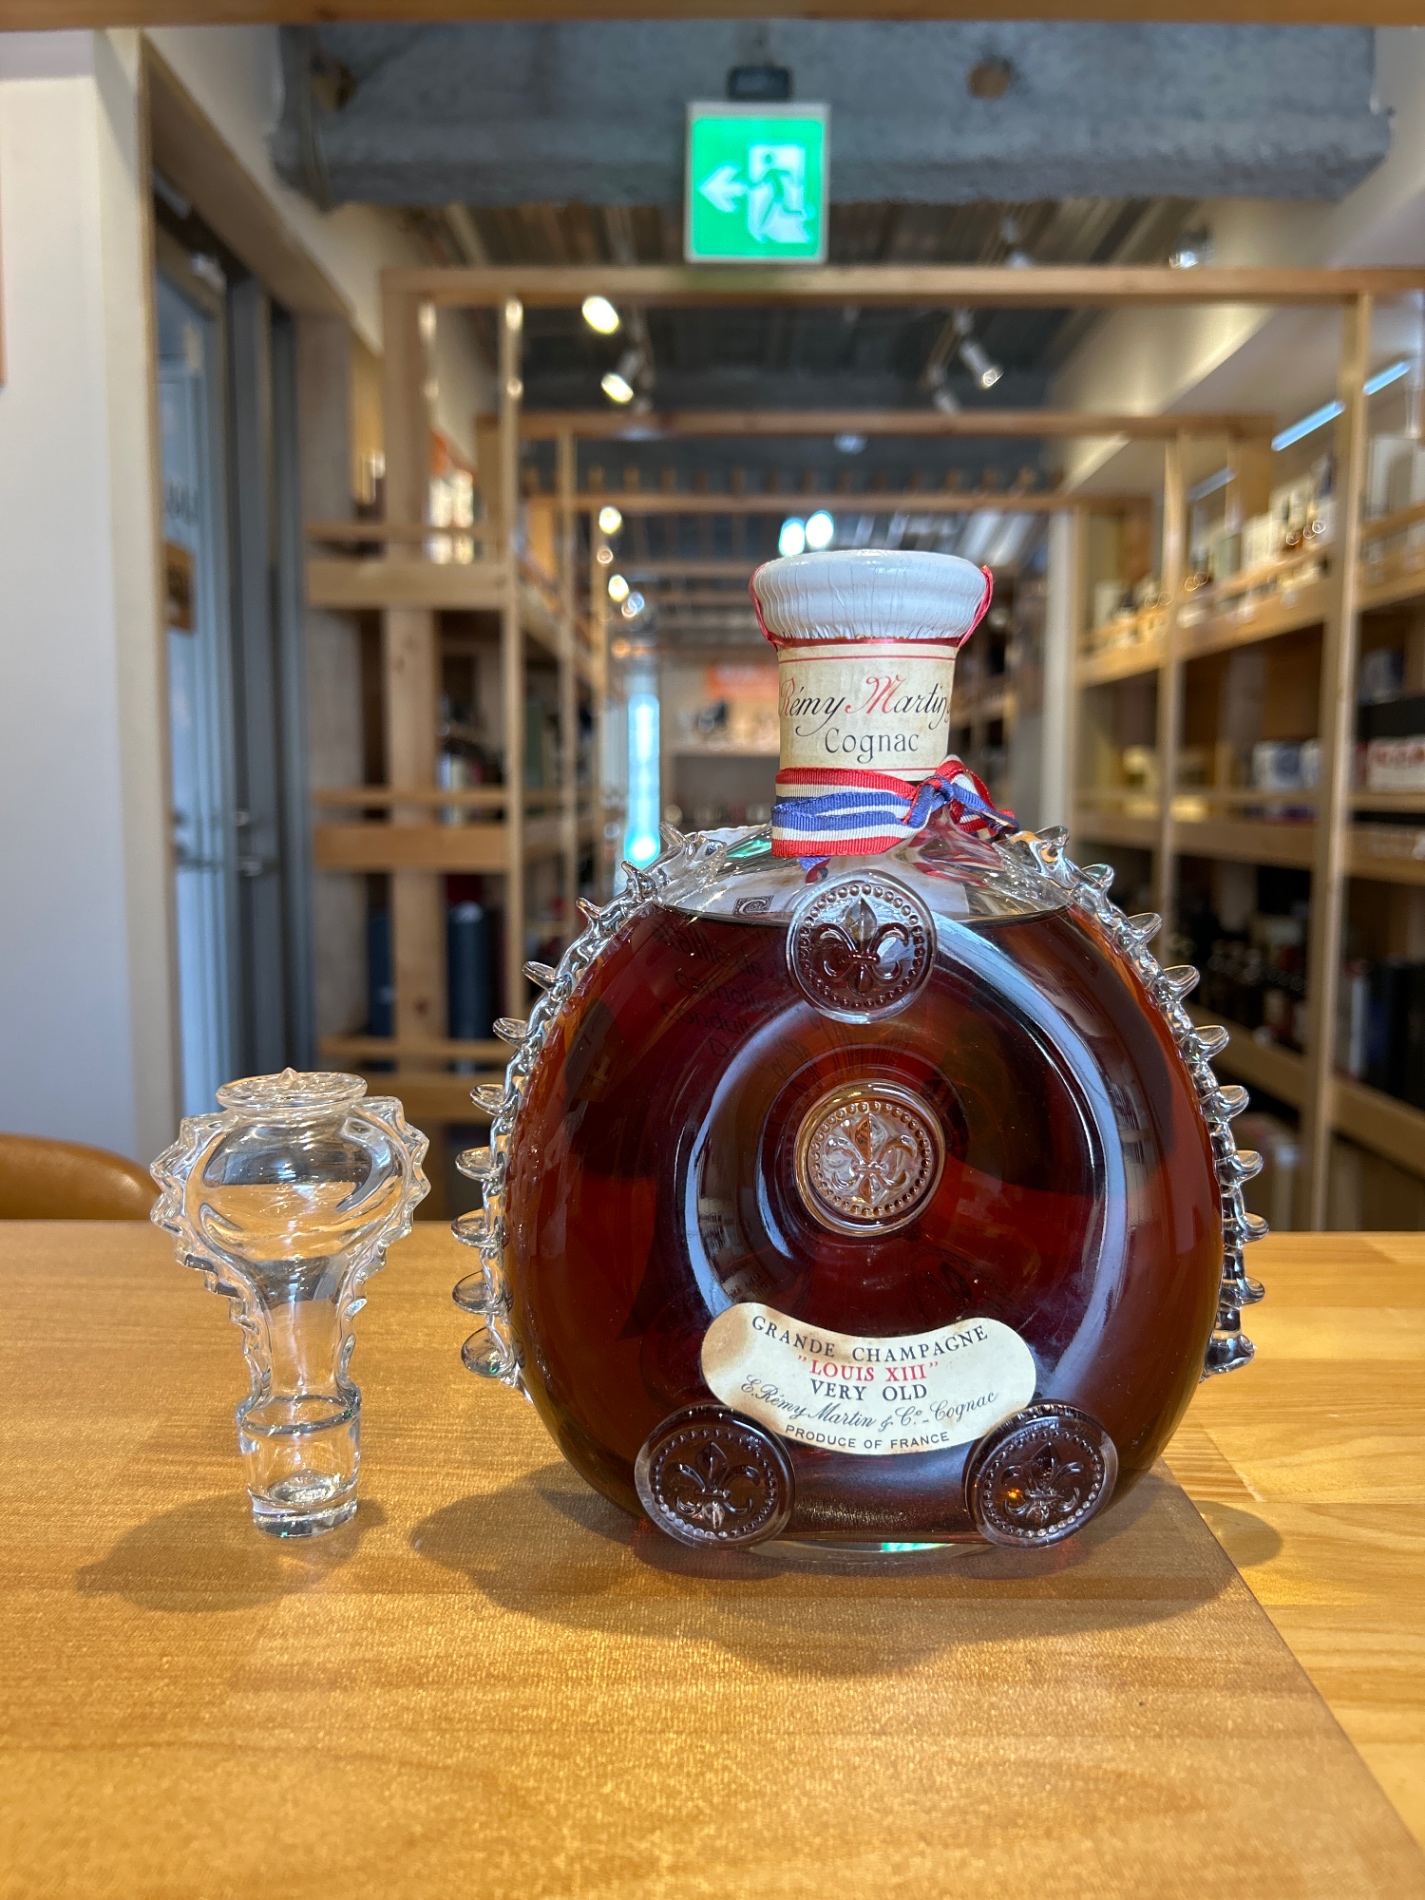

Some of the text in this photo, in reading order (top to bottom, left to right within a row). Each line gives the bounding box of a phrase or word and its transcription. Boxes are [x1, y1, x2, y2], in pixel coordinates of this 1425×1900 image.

[780, 677, 846, 737] Rémy
[845, 674, 950, 730] Martin
[824, 727, 919, 764] Cognac
[752, 1315, 988, 1362] GRANDE CHAMPAGNE
[810, 1378, 927, 1402] VERY OLD
[807, 1402, 877, 1427] Martin
[929, 1391, 998, 1422] Cognac
[785, 1424, 950, 1449] PRODUCE OF FRANCE
